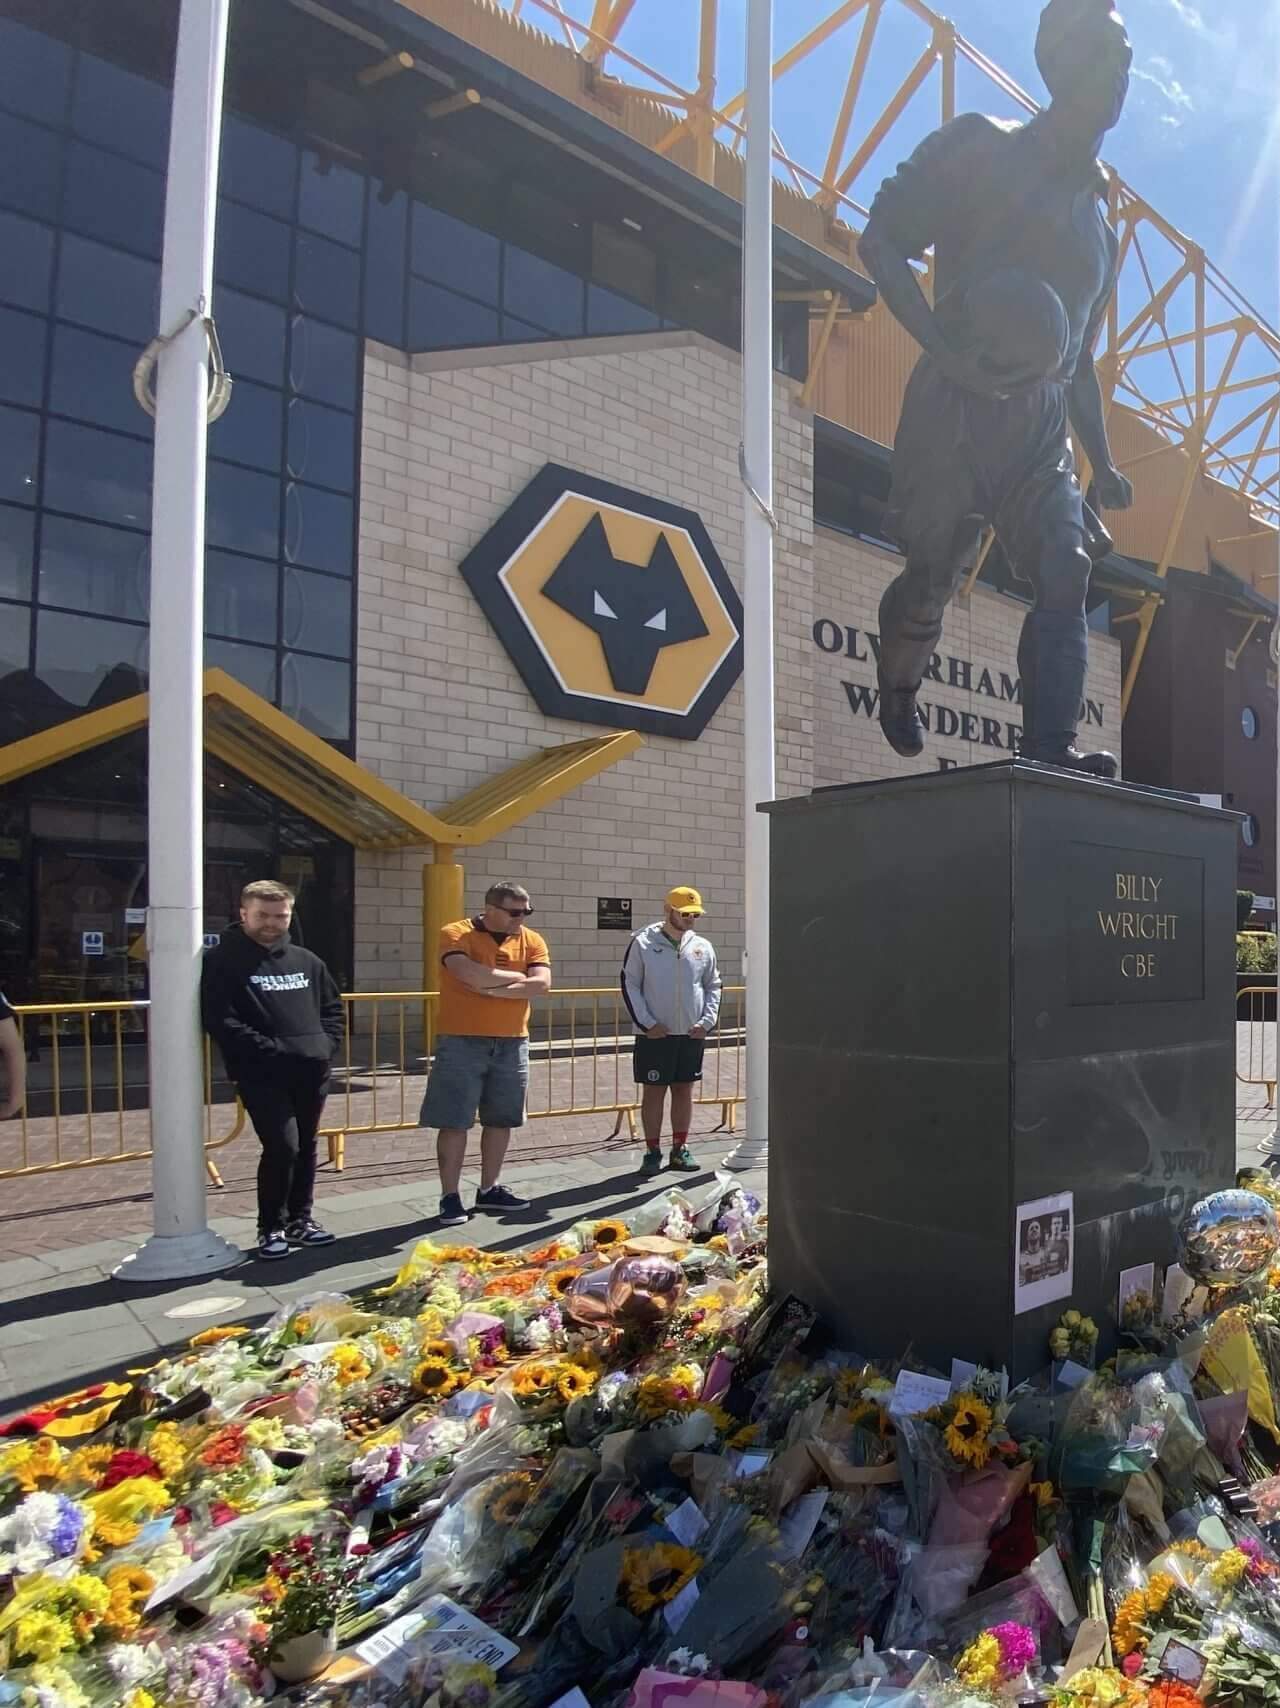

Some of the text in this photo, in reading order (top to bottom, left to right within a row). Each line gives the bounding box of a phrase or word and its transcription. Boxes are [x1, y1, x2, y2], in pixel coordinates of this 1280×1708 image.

[840, 681, 1024, 751] WNDERE
[1115, 872, 1163, 903] BILLY
[1097, 910, 1180, 940] WRIGHT
[1121, 953, 1156, 978] CBE
[261, 978, 310, 992] DONKEY
